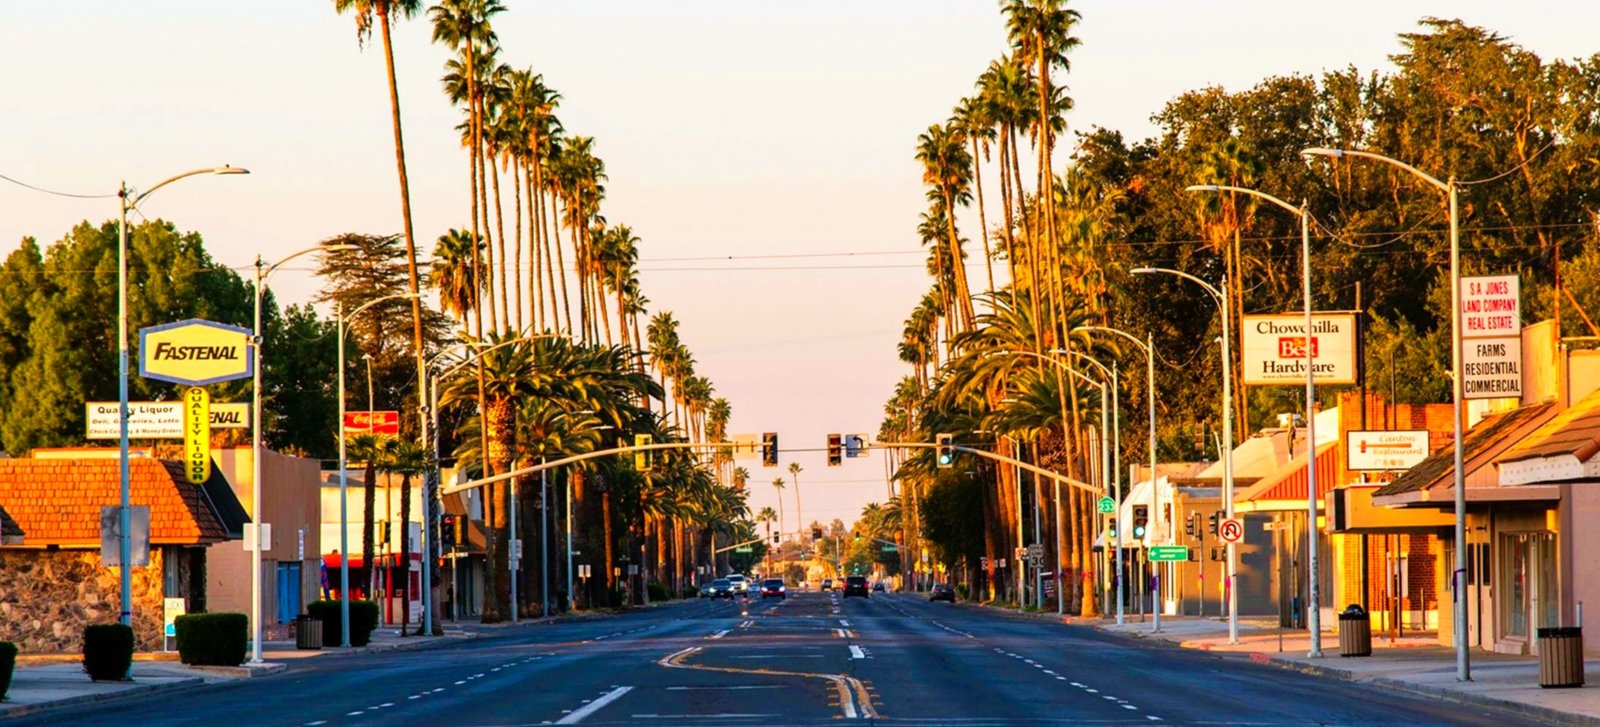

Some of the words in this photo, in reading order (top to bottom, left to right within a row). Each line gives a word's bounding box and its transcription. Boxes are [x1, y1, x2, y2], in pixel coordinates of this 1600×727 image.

[1470, 282, 1475, 295] S
[1486, 281, 1508, 295] JONES
[1463, 300, 1480, 313] LAND
[1484, 299, 1517, 313] COMPANY
[1256, 320, 1339, 334] Chowchilla
[1468, 317, 1485, 330] REAL
[1488, 316, 1512, 329] ESTATE
[1477, 344, 1506, 357] FARMS
[1465, 361, 1518, 375] RESIDENTIAL
[1465, 379, 1520, 393] COMMERCIAL
[97, 406, 136, 415] Qualy
[140, 406, 174, 414] Liquor
[191, 388, 202, 435] QUALITY
[353, 413, 386, 425] CocaCola
[192, 439, 204, 480] LIQUOR
